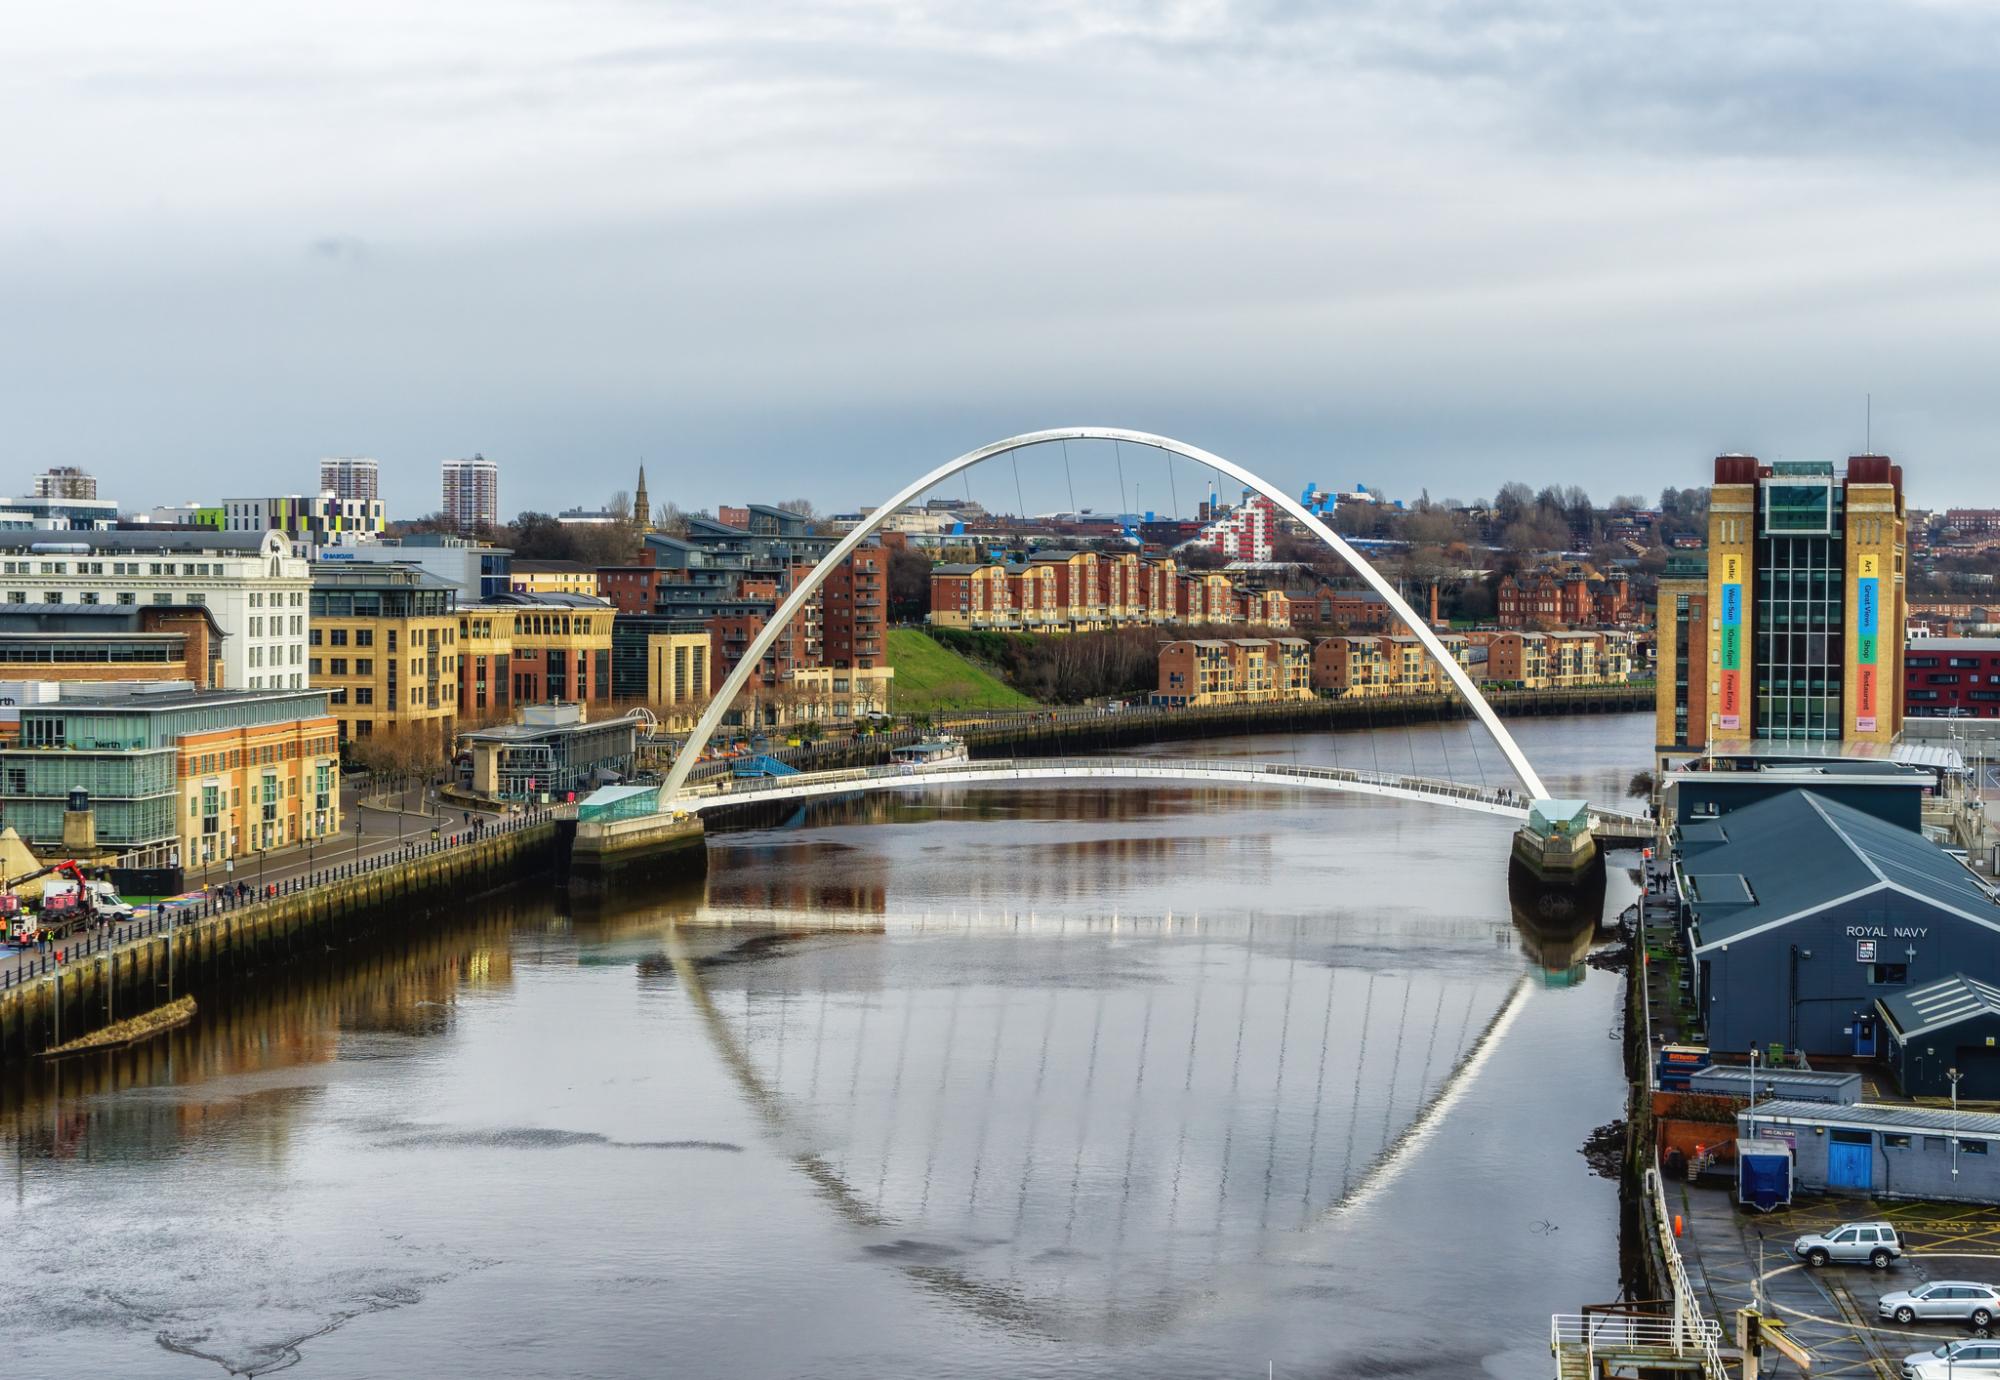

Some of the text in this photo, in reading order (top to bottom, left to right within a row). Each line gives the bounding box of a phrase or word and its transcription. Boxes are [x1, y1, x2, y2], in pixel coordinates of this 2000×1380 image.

[1728, 559, 1736, 580] Baltic
[1864, 560, 1872, 573] Art
[1864, 584, 1872, 606] Great
[1863, 639, 1871, 659] Shop
[1863, 670, 1871, 711] Restaurant
[0, 697, 15, 706] rth
[1726, 691, 1734, 711] Entry
[95, 741, 121, 749] North
[1846, 926, 1928, 938] ROYAL NAVY
